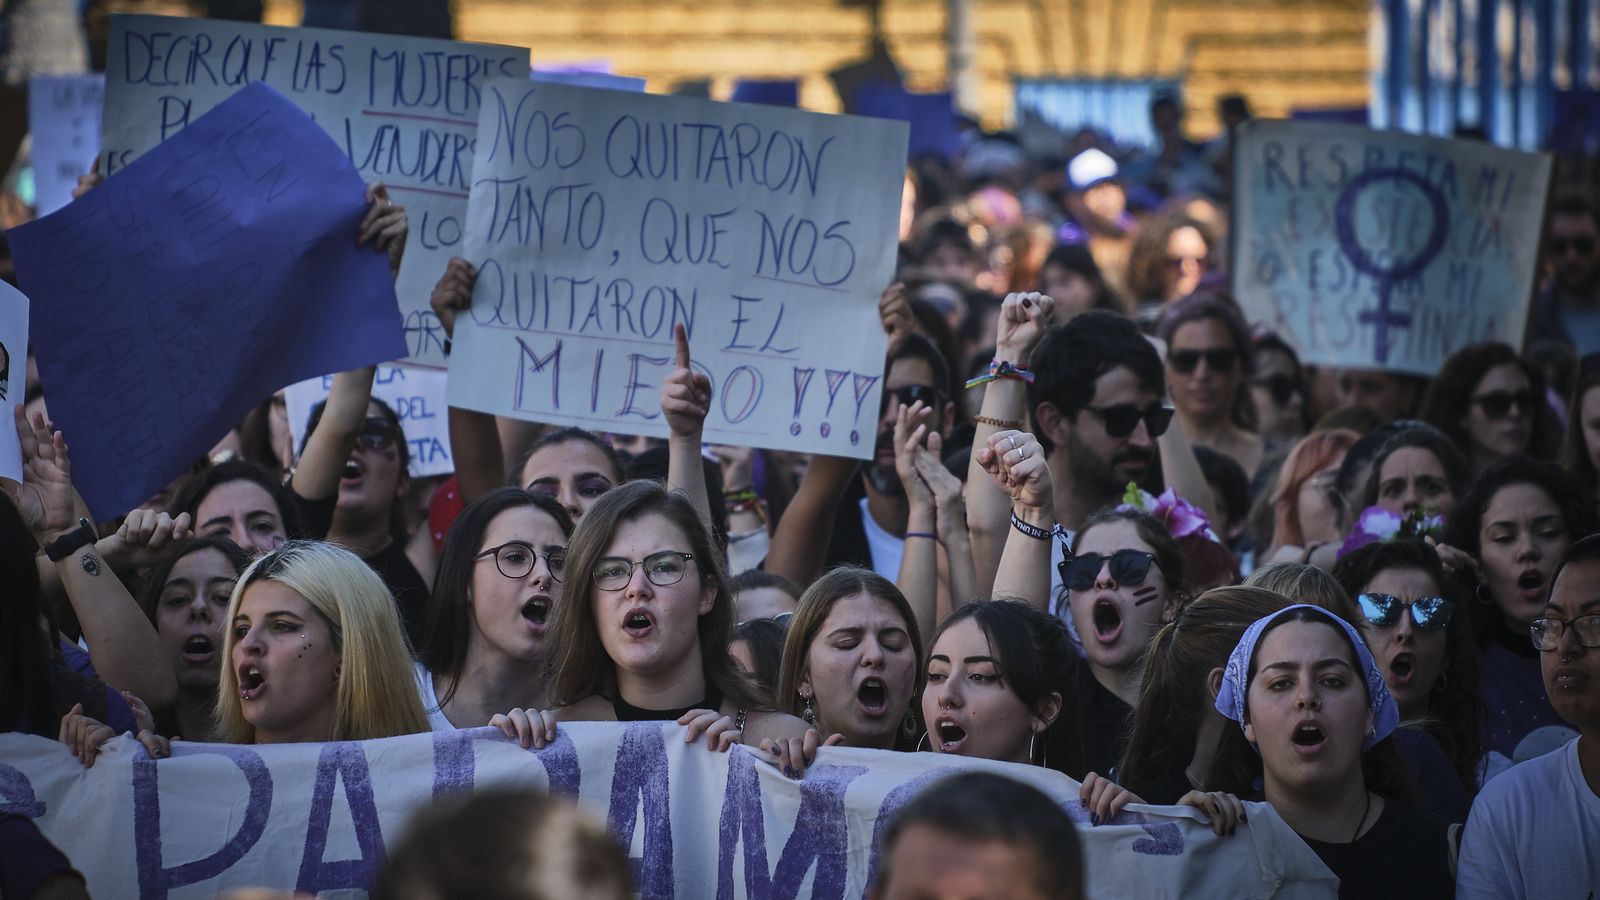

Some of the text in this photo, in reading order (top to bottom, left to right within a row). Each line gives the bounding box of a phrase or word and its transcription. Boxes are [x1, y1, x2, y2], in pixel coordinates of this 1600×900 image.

[221, 34, 286, 86] QUE
[292, 39, 346, 94] LAS
[345, 117, 477, 191] VENDER
[486, 85, 837, 199] NOS QUITARON
[473, 174, 857, 287] TANTO, QUE NOS
[469, 257, 800, 354] QUITARON EL
